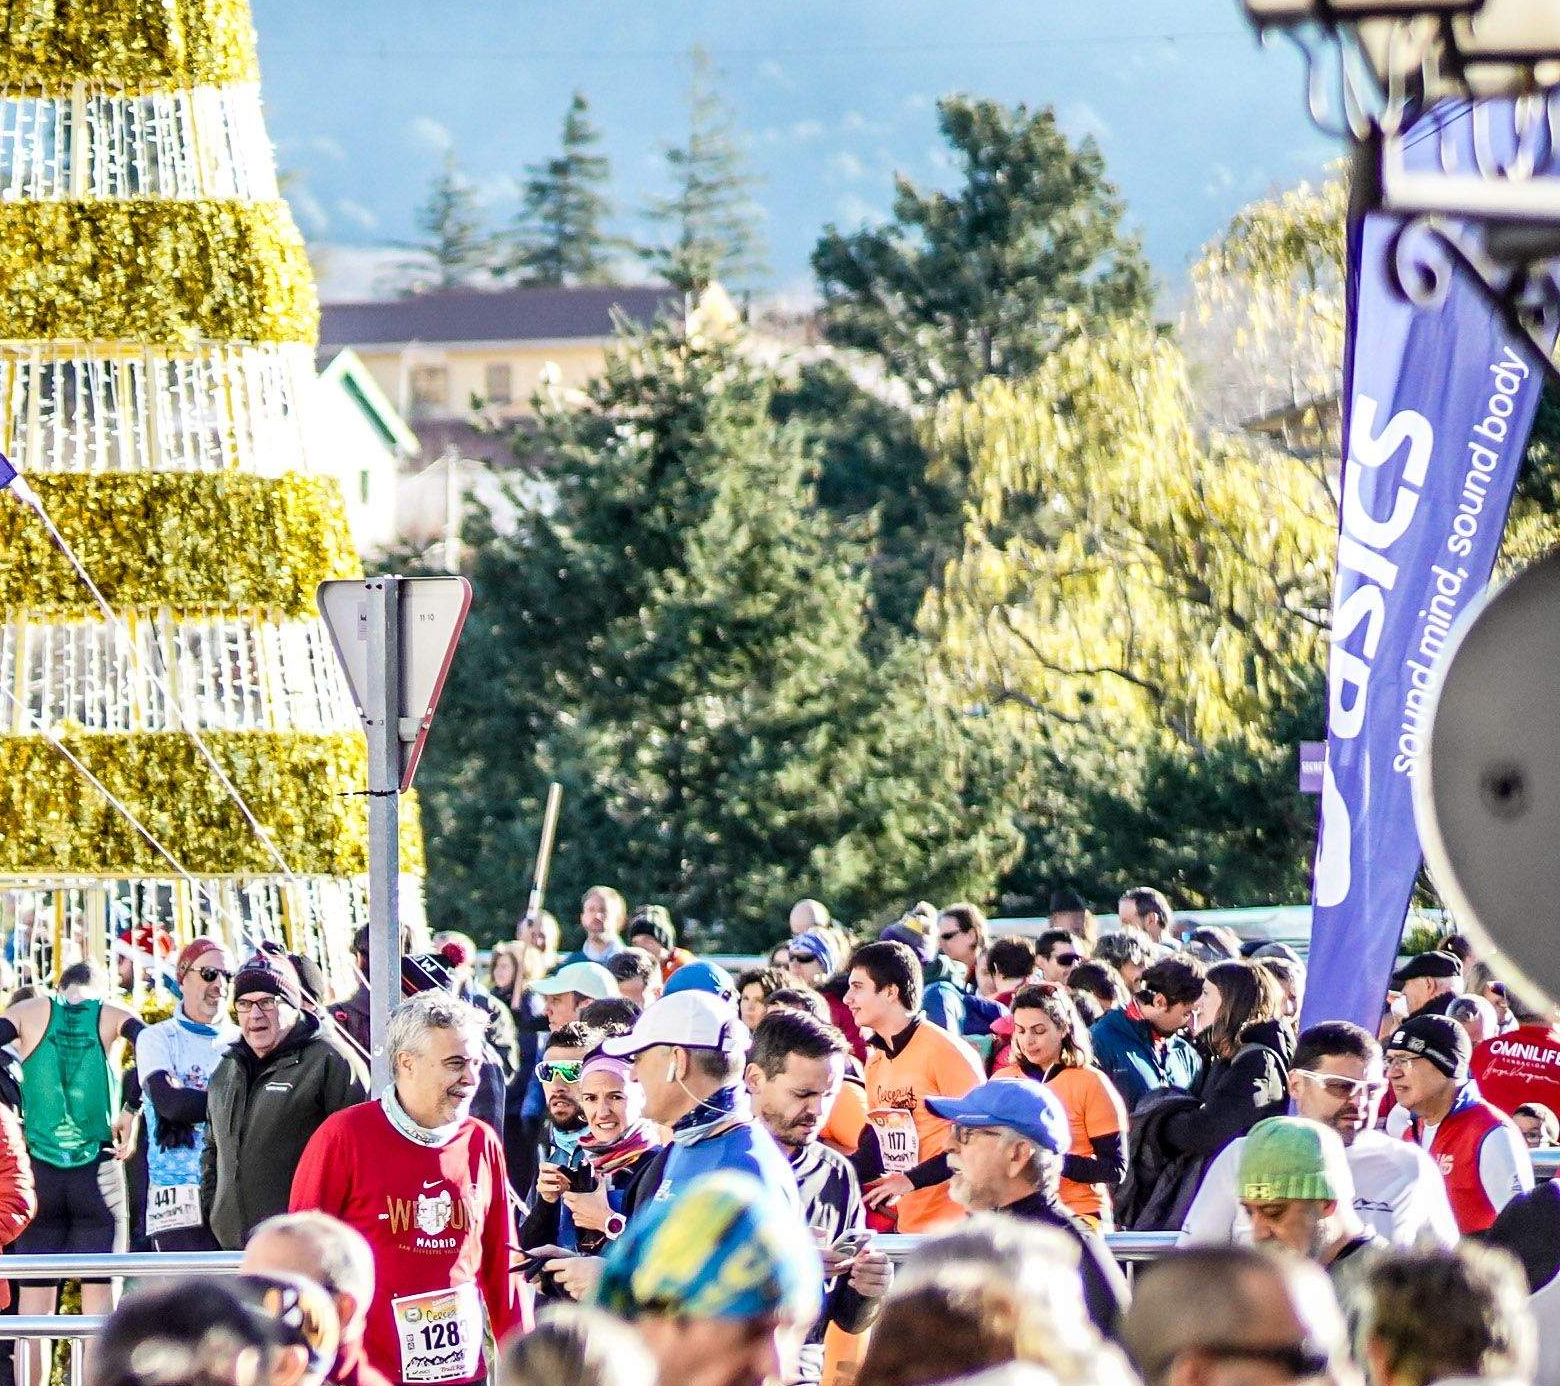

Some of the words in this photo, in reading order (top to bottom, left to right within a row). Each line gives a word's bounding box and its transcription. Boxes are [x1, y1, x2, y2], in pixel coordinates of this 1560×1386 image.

[1472, 345, 1530, 444] body
[1447, 441, 1499, 557] sound
[1419, 564, 1469, 663] mind,
[1393, 660, 1438, 777] sound
[155, 1187, 177, 1208] 447
[416, 1237, 457, 1249] MADRID
